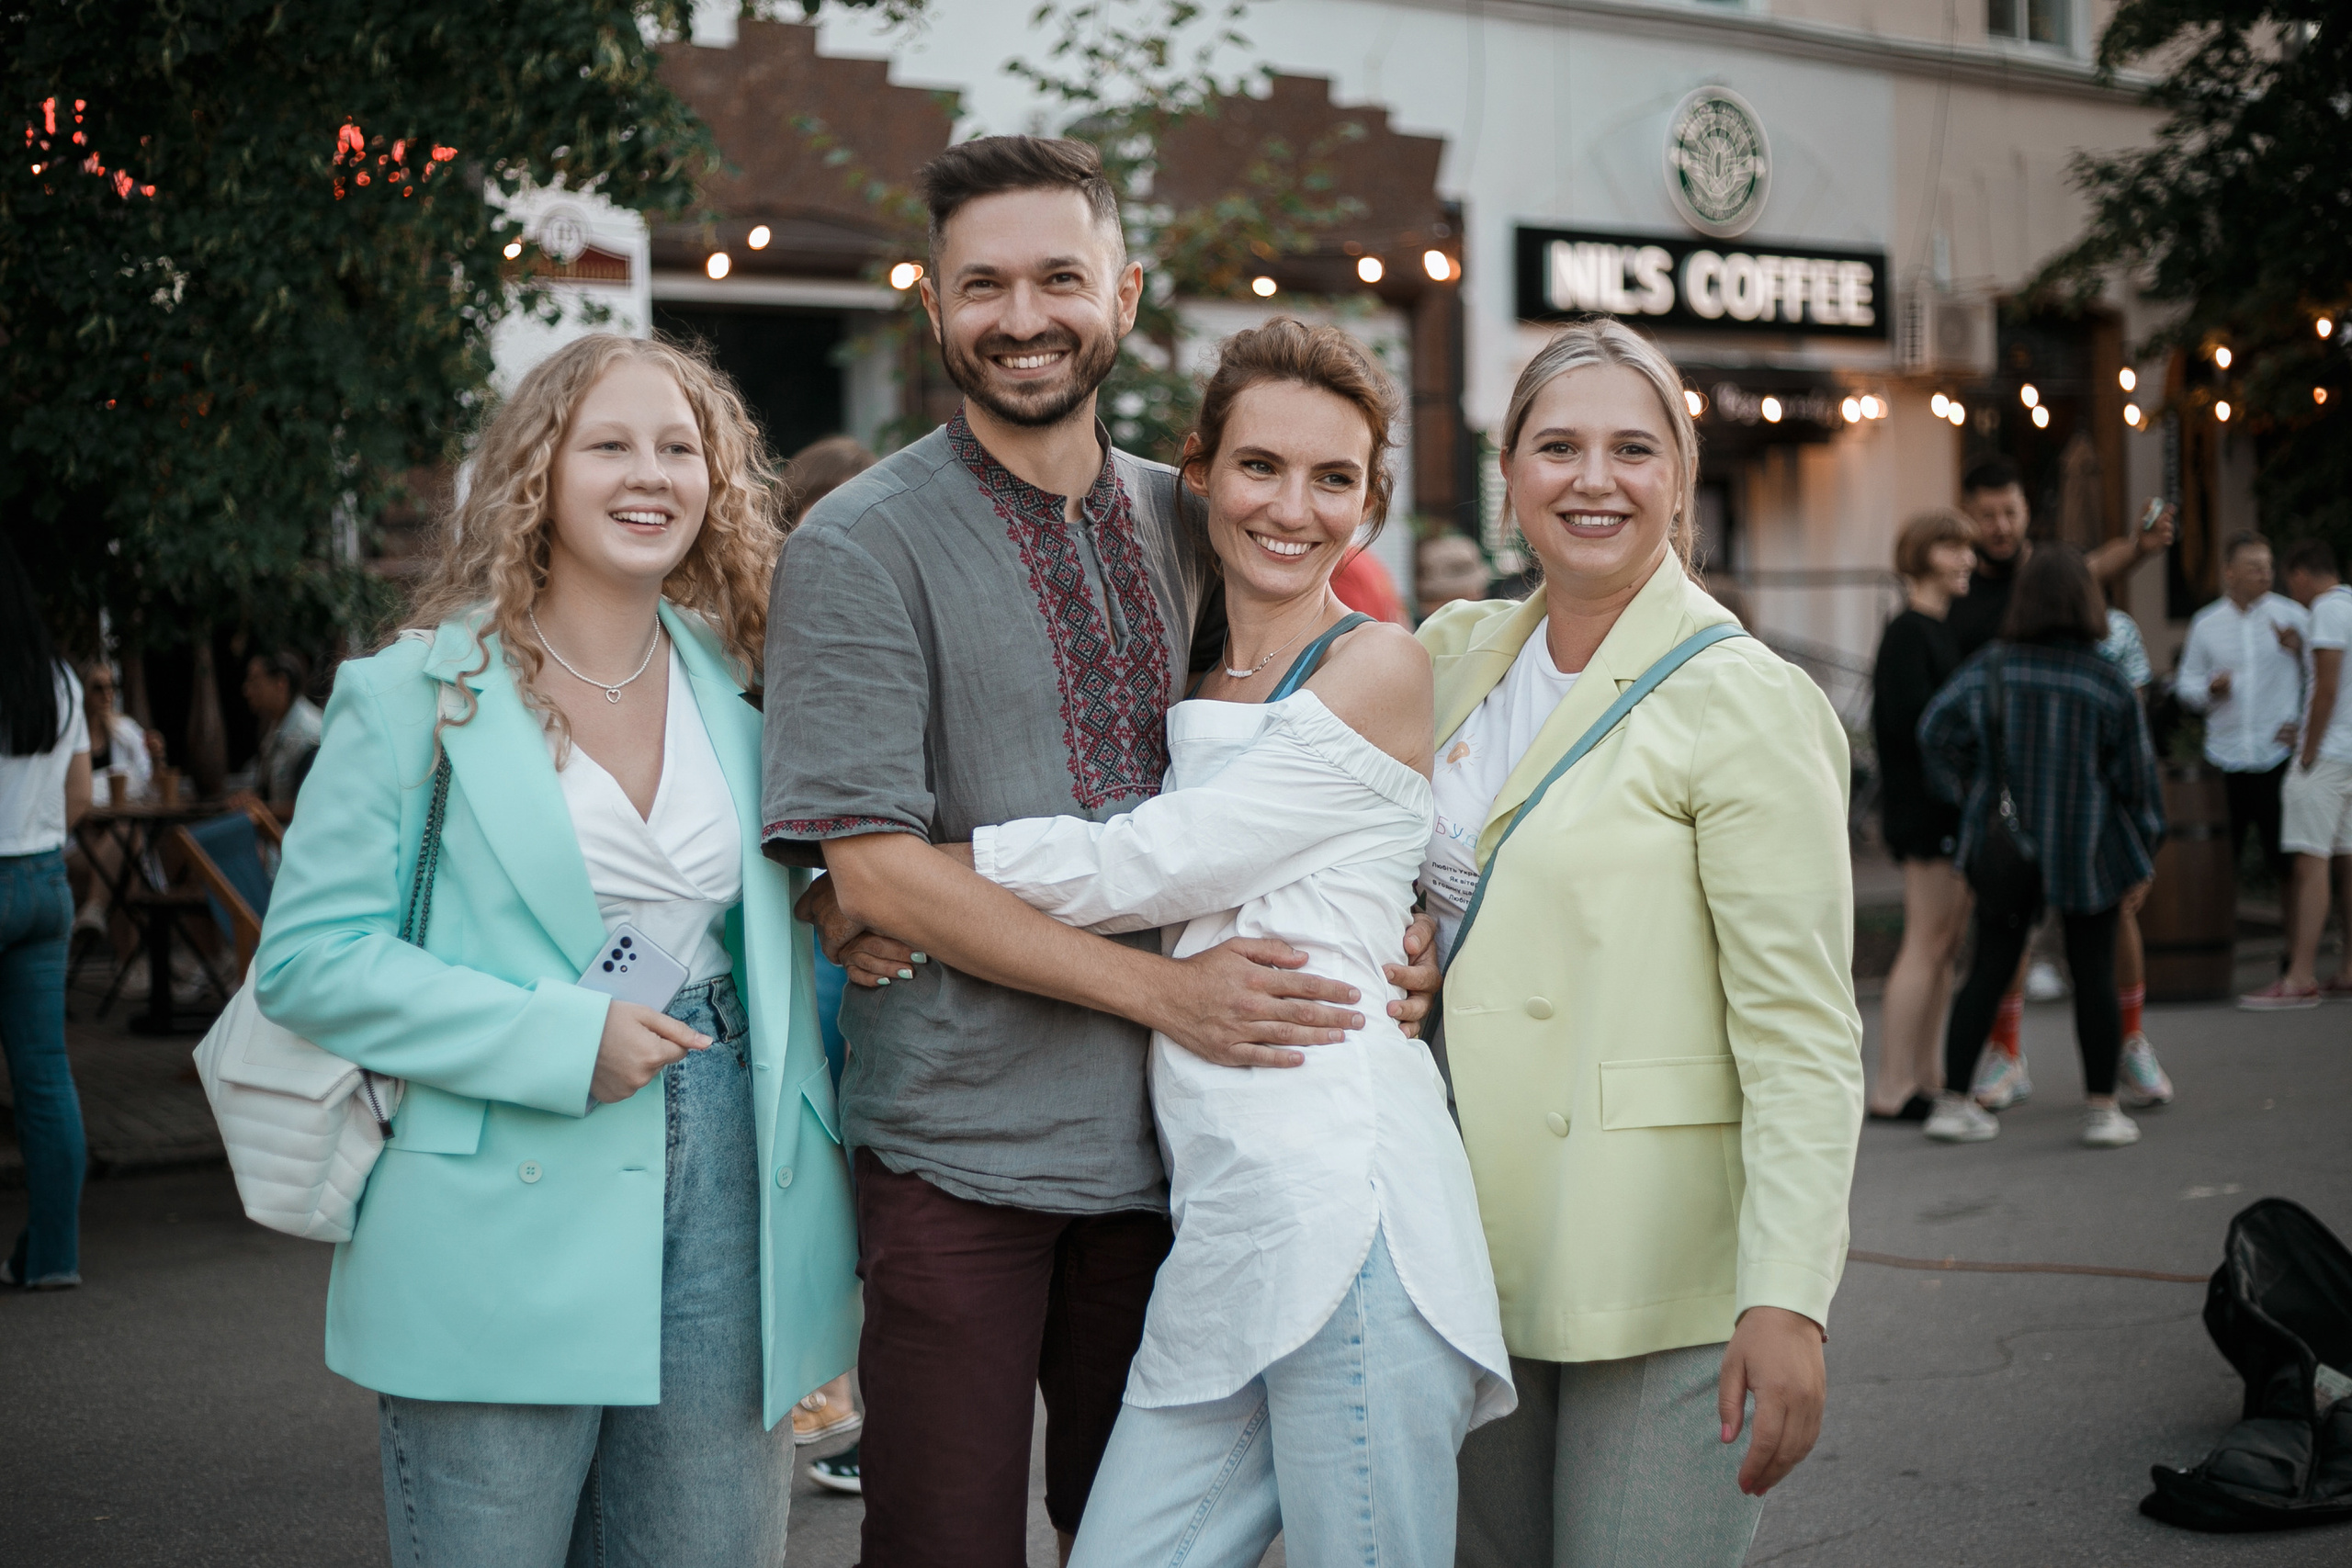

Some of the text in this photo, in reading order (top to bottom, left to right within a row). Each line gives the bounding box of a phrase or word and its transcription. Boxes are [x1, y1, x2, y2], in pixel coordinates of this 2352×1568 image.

[1544, 240, 1876, 327] NIL'S COFFEE
[1435, 816, 1477, 849] БУД
[1458, 868, 1480, 878] Укра
[1449, 894, 1470, 905] Любіт
